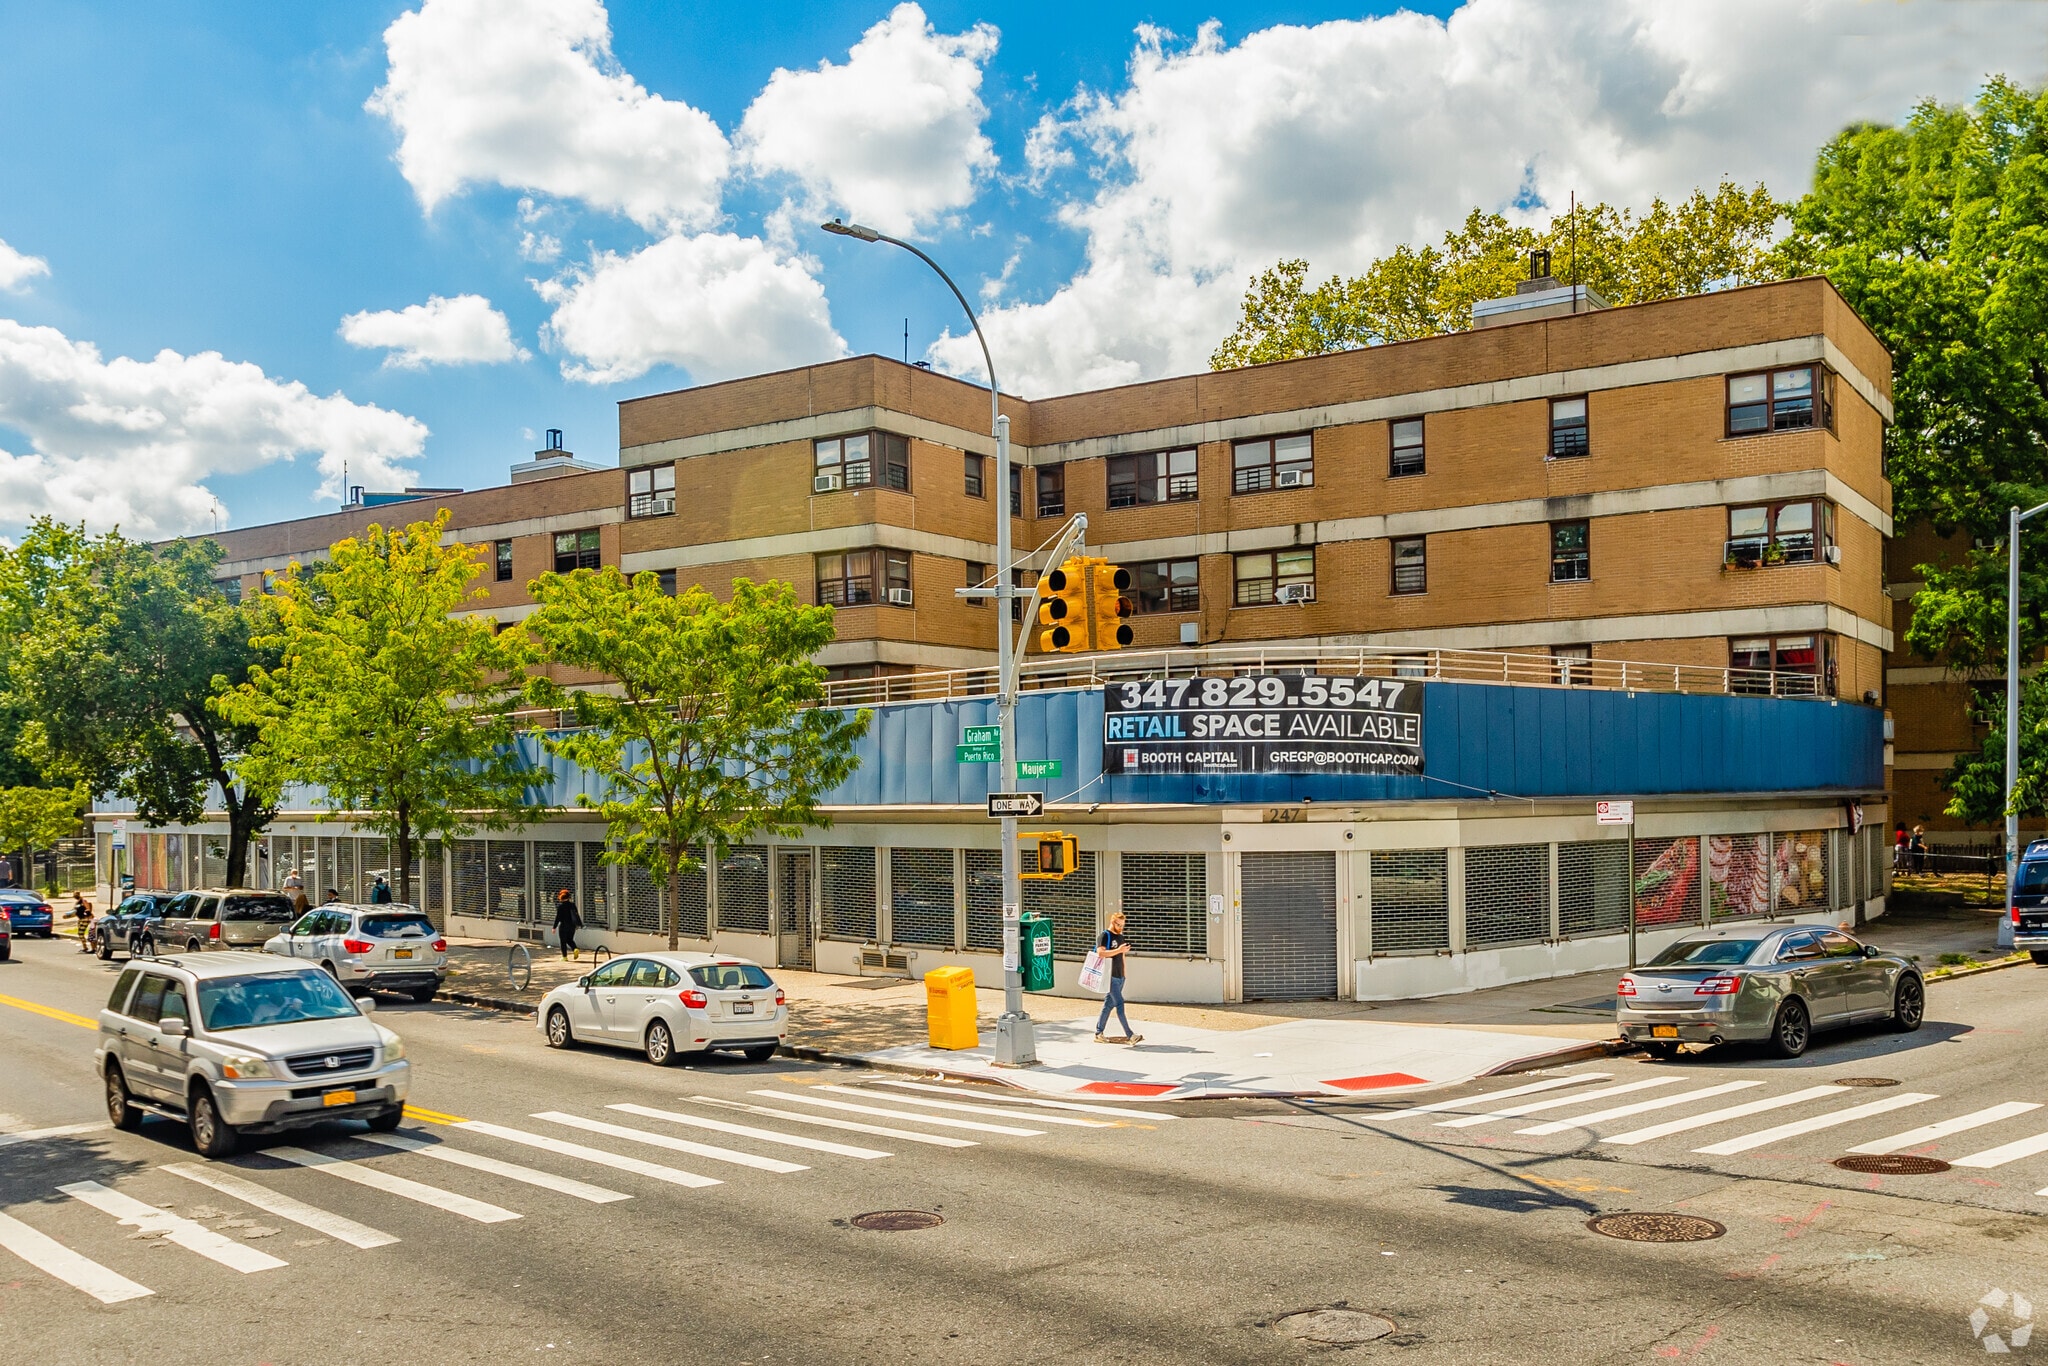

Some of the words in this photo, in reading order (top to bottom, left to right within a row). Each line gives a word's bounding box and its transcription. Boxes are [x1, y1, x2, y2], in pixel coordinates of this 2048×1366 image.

[1120, 677, 1405, 709] 347.829.5547
[1108, 715, 1187, 739] RETAIL
[1192, 713, 1281, 738] SPACE
[1288, 713, 1417, 742] AVAILABLE
[967, 729, 992, 743] Graham
[964, 751, 982, 761] Puerto
[982, 751, 995, 761] Rico
[1141, 751, 1182, 764] BOOTH
[1185, 751, 1238, 764] CAPITAL
[1269, 750, 1419, 766] GREGP@BOOTHCAP.COM
[1022, 762, 1047, 778] Maujer
[1049, 762, 1055, 770] St
[996, 800, 1013, 810] ONE
[1019, 800, 1035, 809] WAY
[1269, 808, 1300, 823] 247
